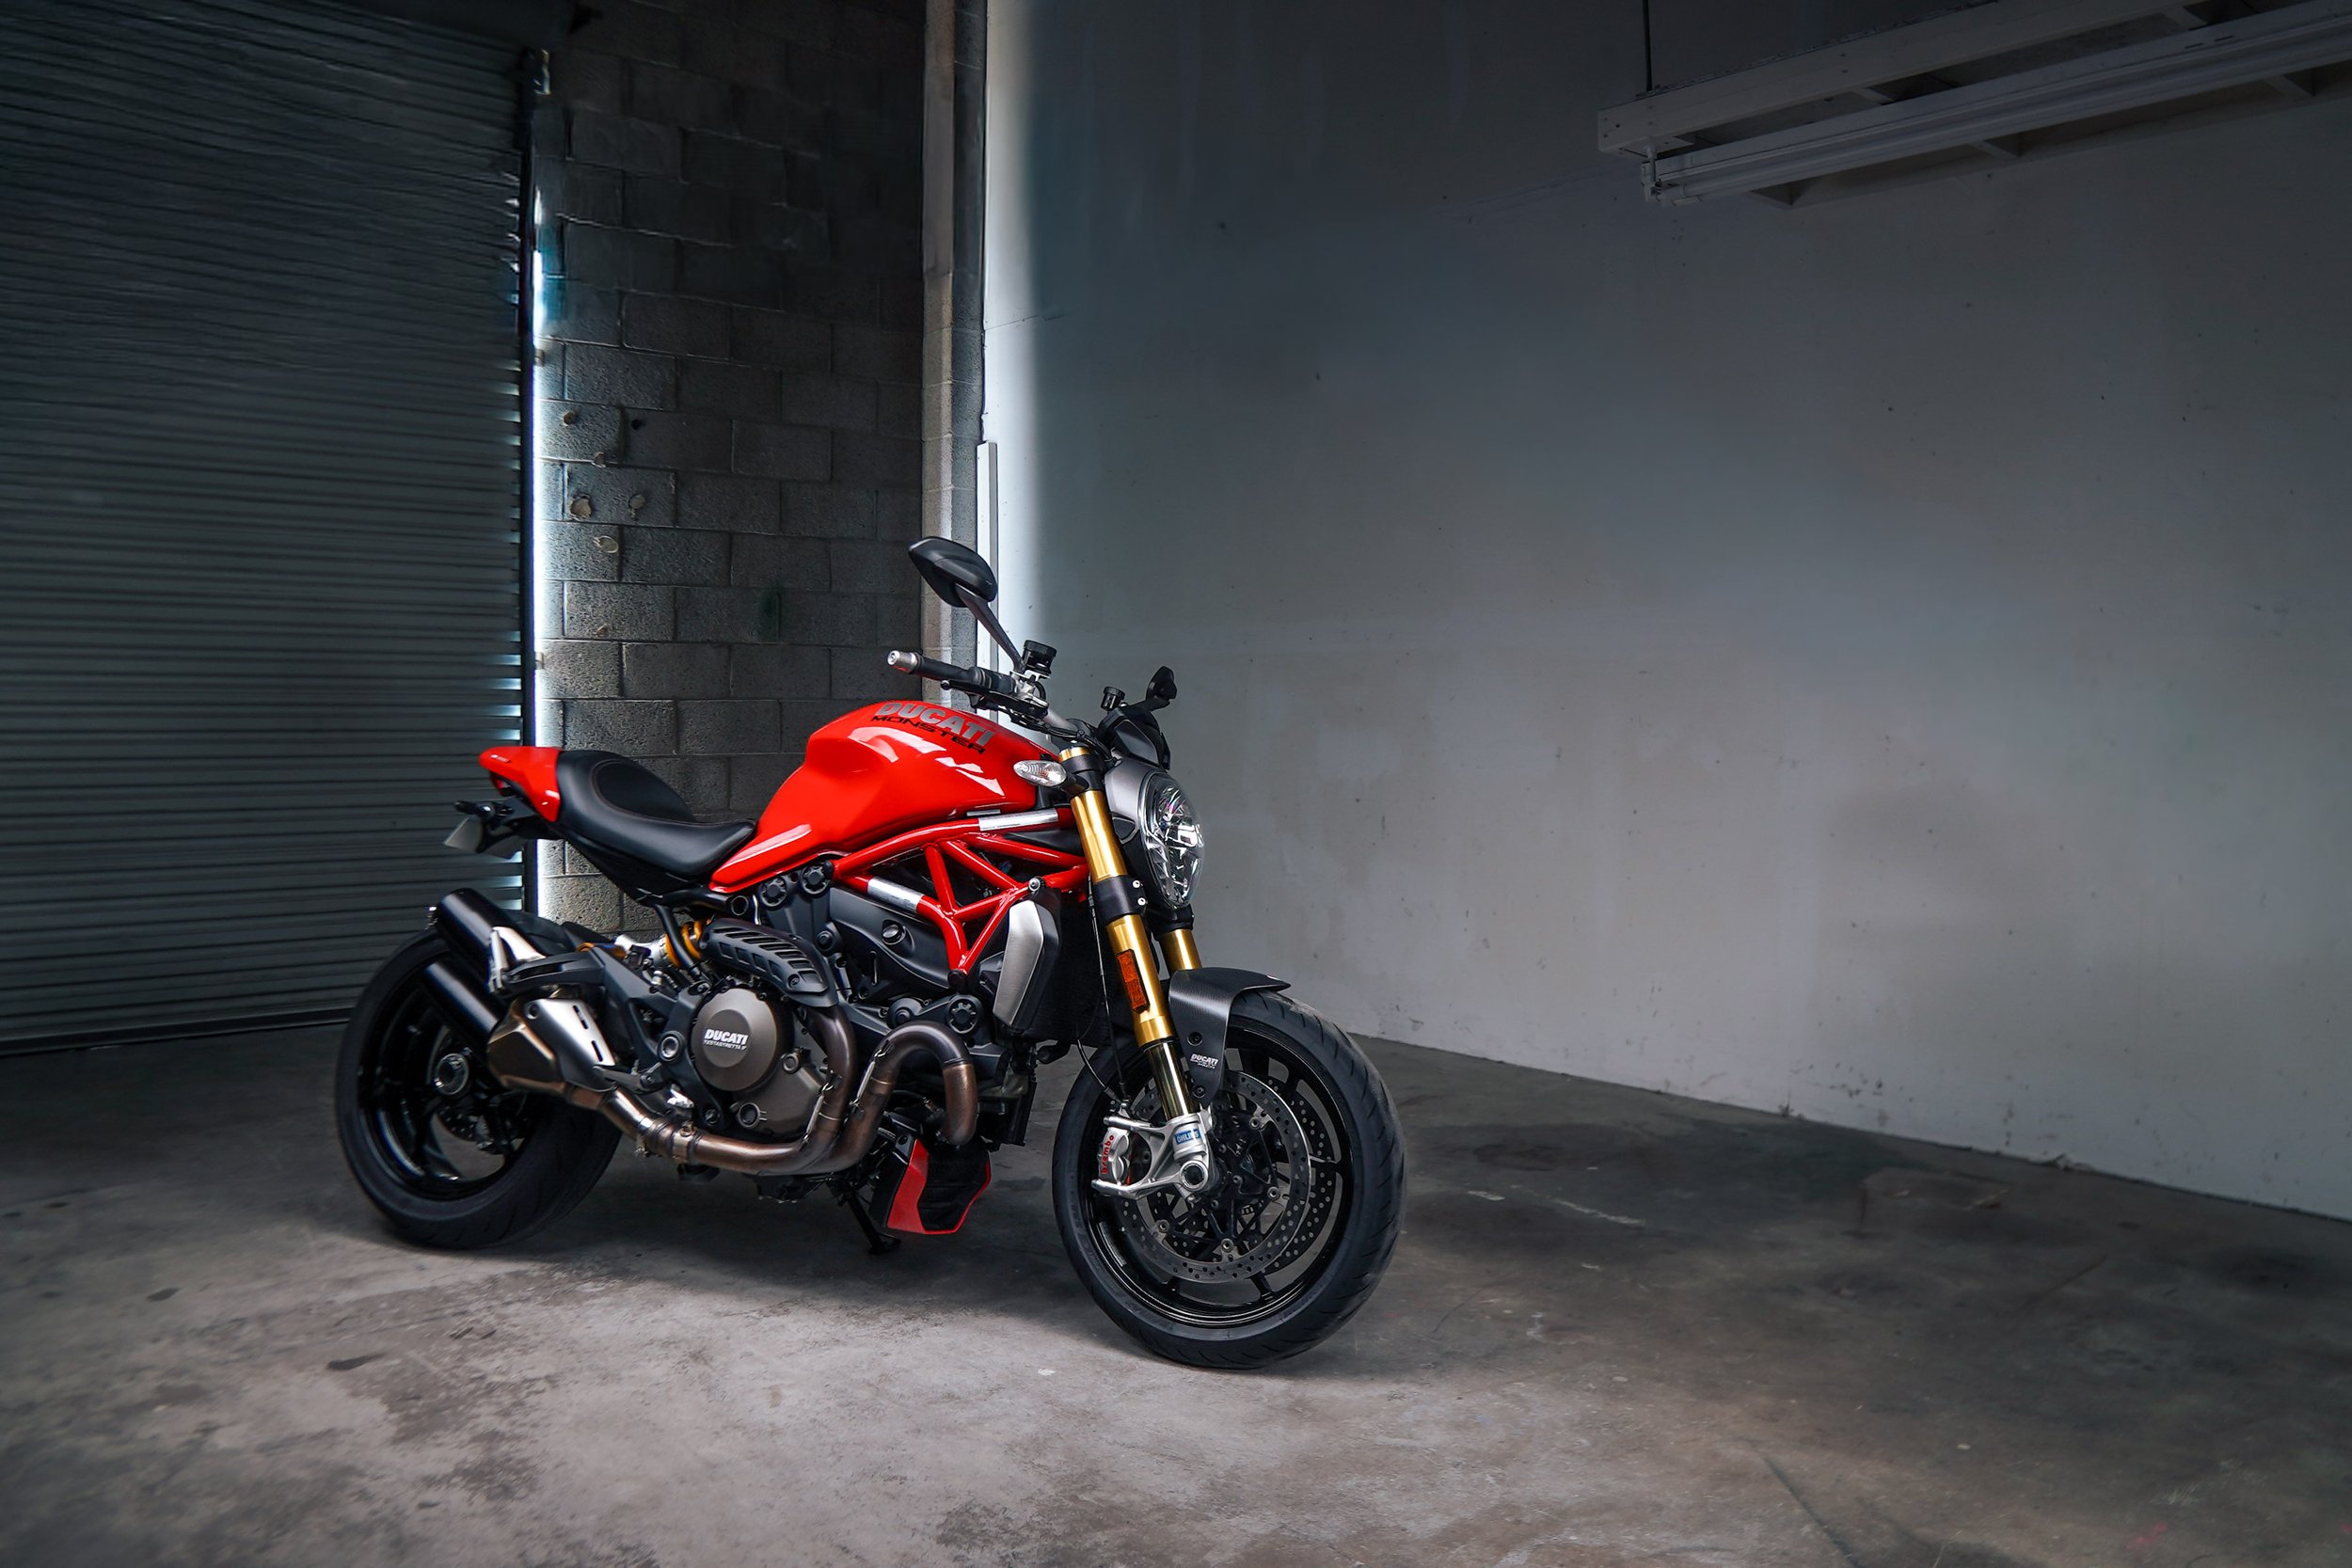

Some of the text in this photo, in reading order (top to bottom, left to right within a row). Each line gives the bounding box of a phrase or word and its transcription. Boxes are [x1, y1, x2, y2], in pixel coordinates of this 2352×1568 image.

[871, 715, 986, 754] MONSTER
[876, 703, 994, 747] DUCATI
[704, 1028, 749, 1045] DUCATI
[1190, 1053, 1219, 1066] DUCATI
[1101, 1134, 1115, 1175] brembo
